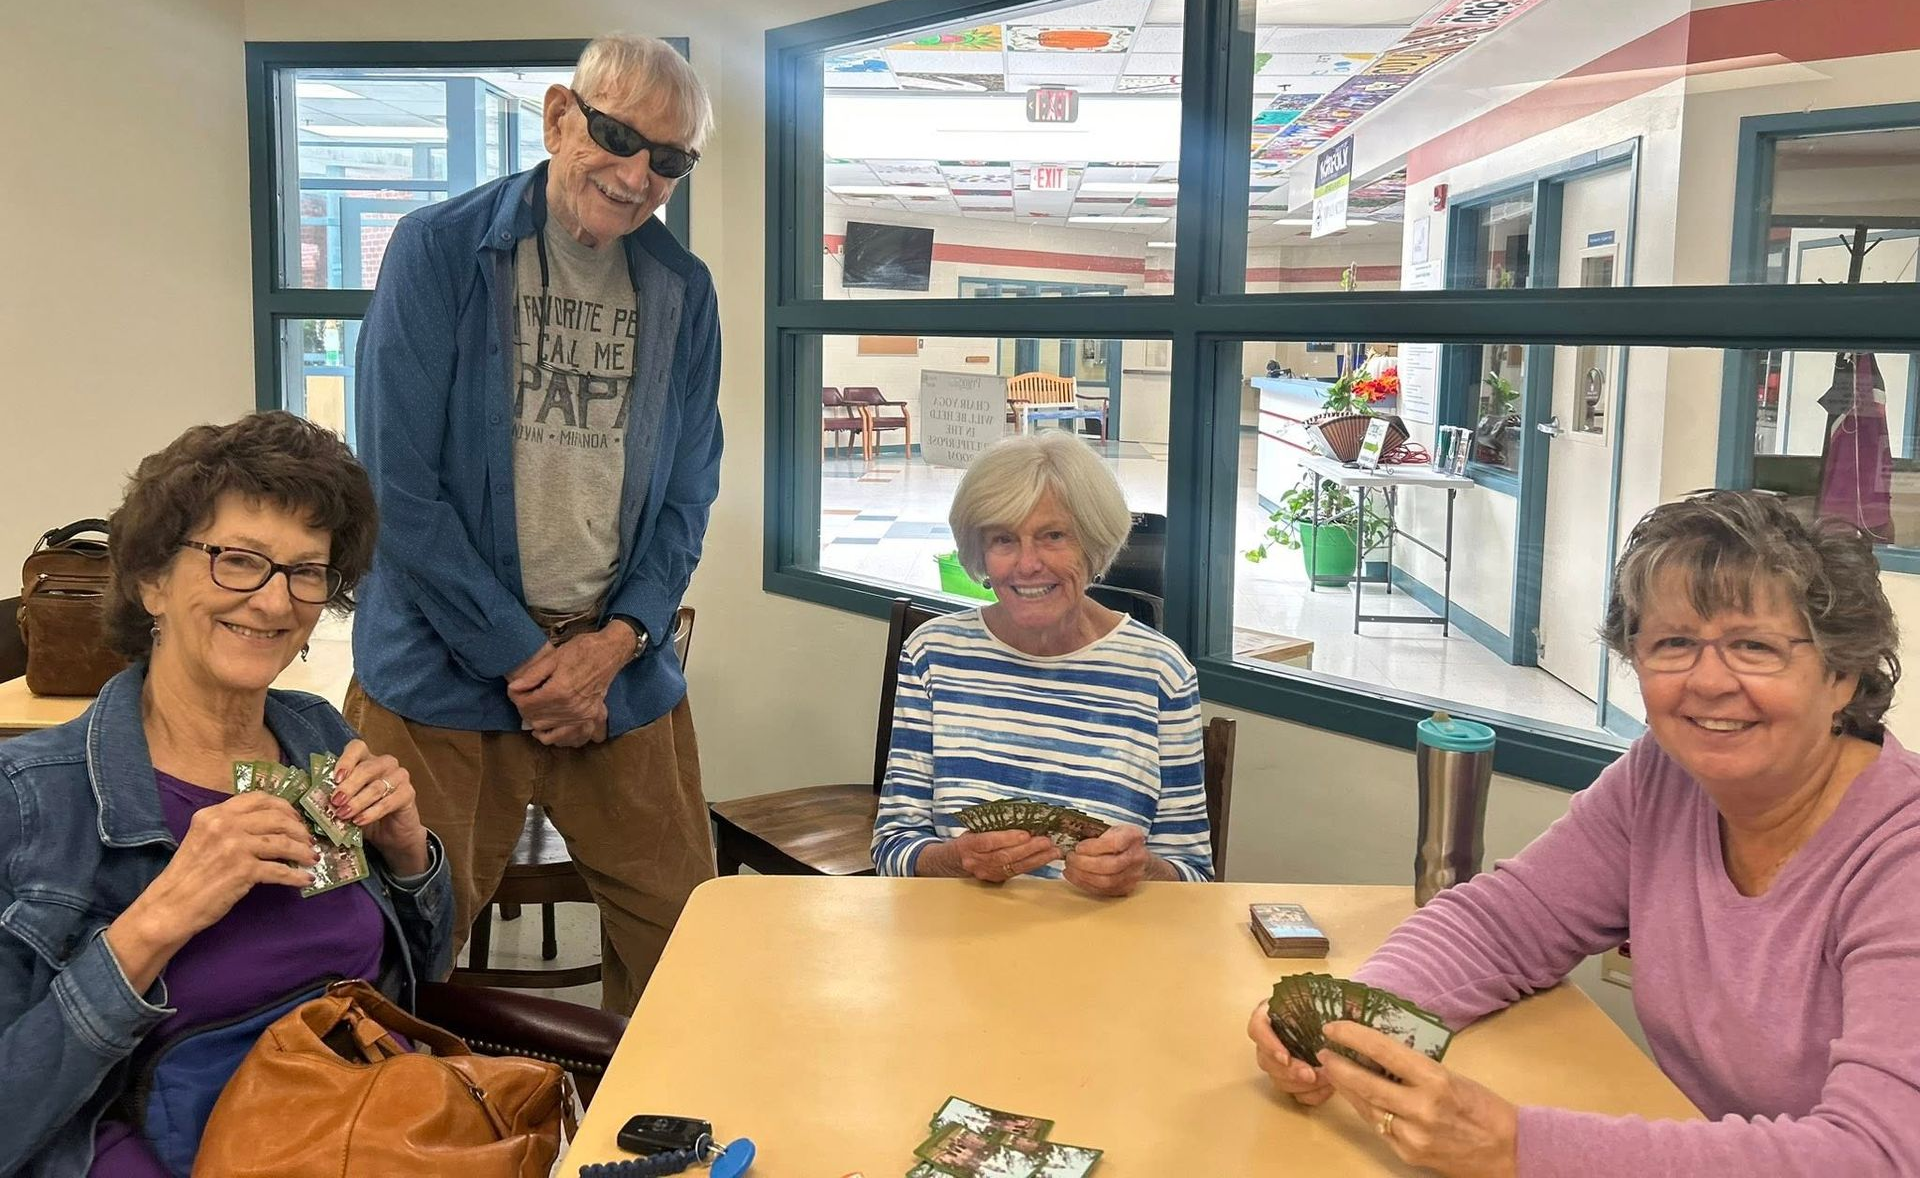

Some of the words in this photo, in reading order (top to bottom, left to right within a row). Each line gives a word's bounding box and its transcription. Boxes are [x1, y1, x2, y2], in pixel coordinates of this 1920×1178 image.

[1037, 167, 1064, 189] EXIT
[523, 295, 604, 332] FAVORITE
[594, 341, 625, 371] ME
